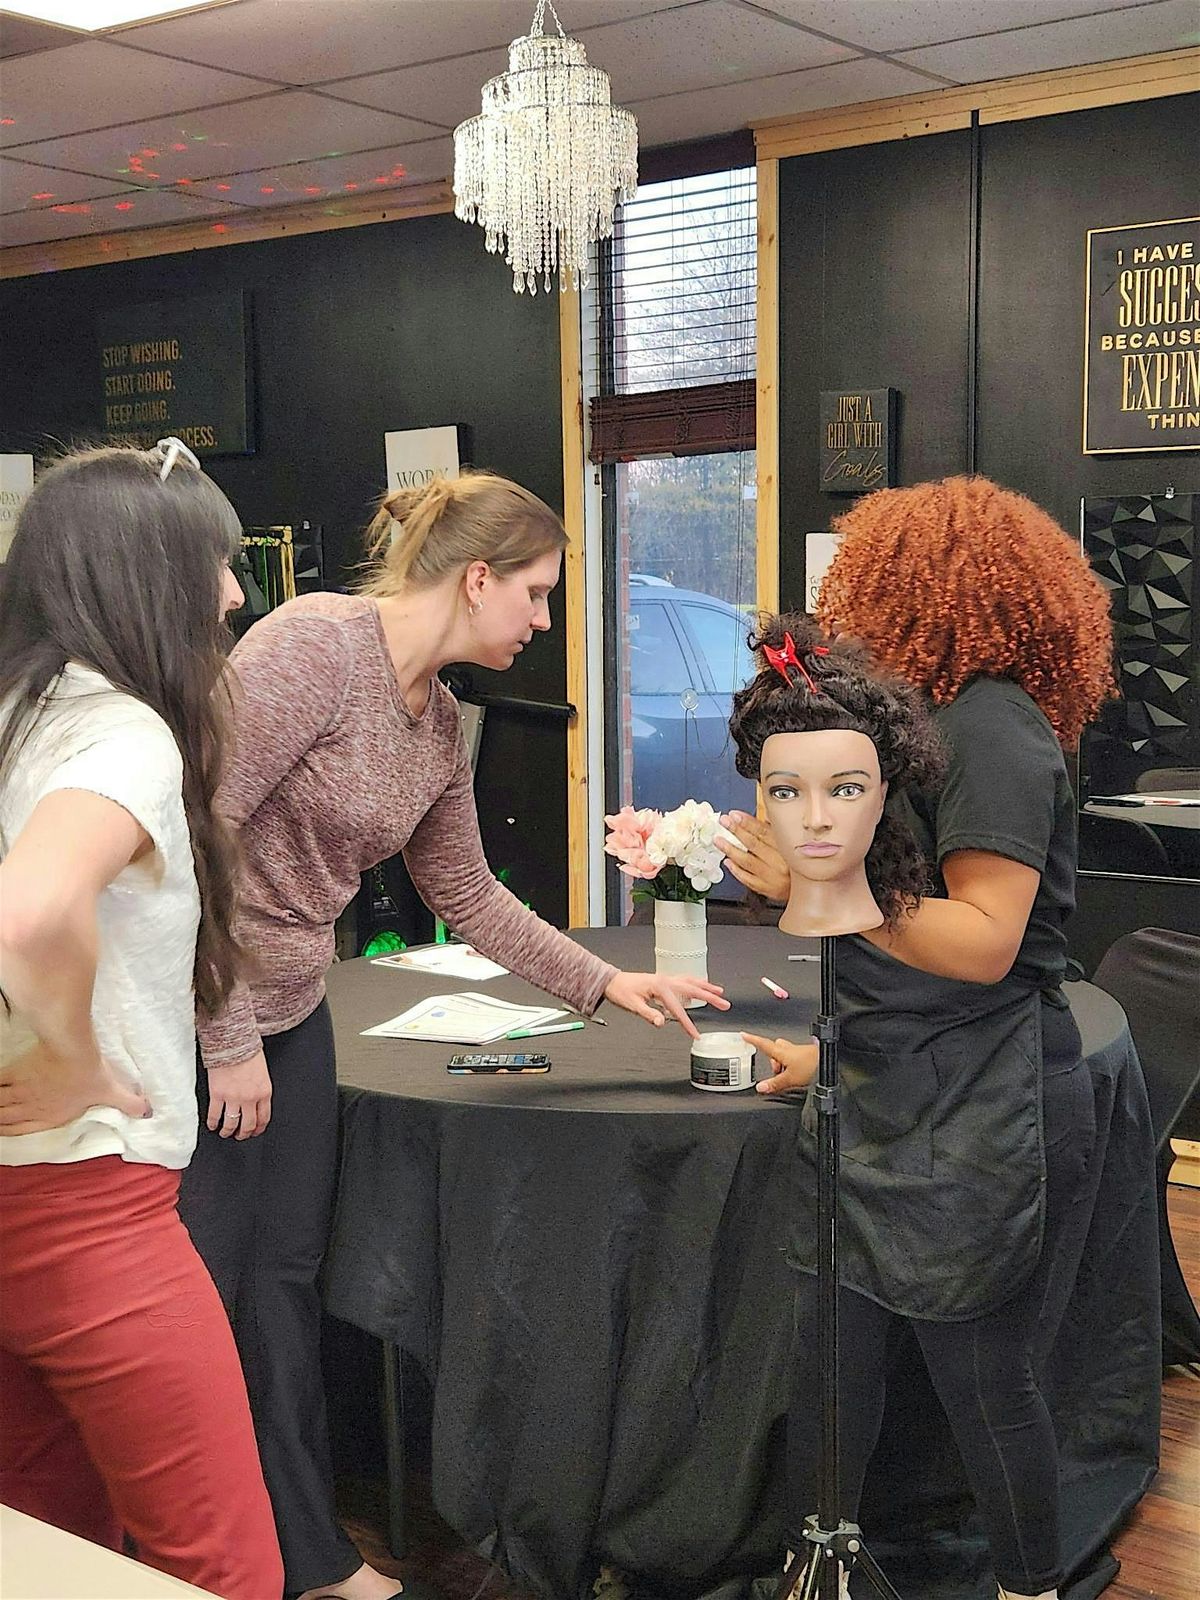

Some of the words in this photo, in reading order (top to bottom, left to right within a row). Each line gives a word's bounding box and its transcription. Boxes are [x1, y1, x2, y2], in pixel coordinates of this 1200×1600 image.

[1116, 250, 1123, 265] I
[1133, 243, 1194, 263] HAVE
[1102, 329, 1200, 350] BECAUSE
[103, 346, 128, 368] STOP
[130, 340, 183, 364] WISHING.
[105, 373, 135, 396] START
[137, 370, 176, 393] DOING.
[1120, 351, 1200, 411] EXPEN
[105, 403, 132, 426] KEEP
[134, 399, 171, 422] GOING.
[837, 396, 862, 422] JUST
[864, 395, 872, 422] A
[1147, 413, 1200, 430] THIN
[827, 423, 850, 449] GIRL
[853, 422, 882, 448] WITH
[823, 449, 887, 487] Goals
